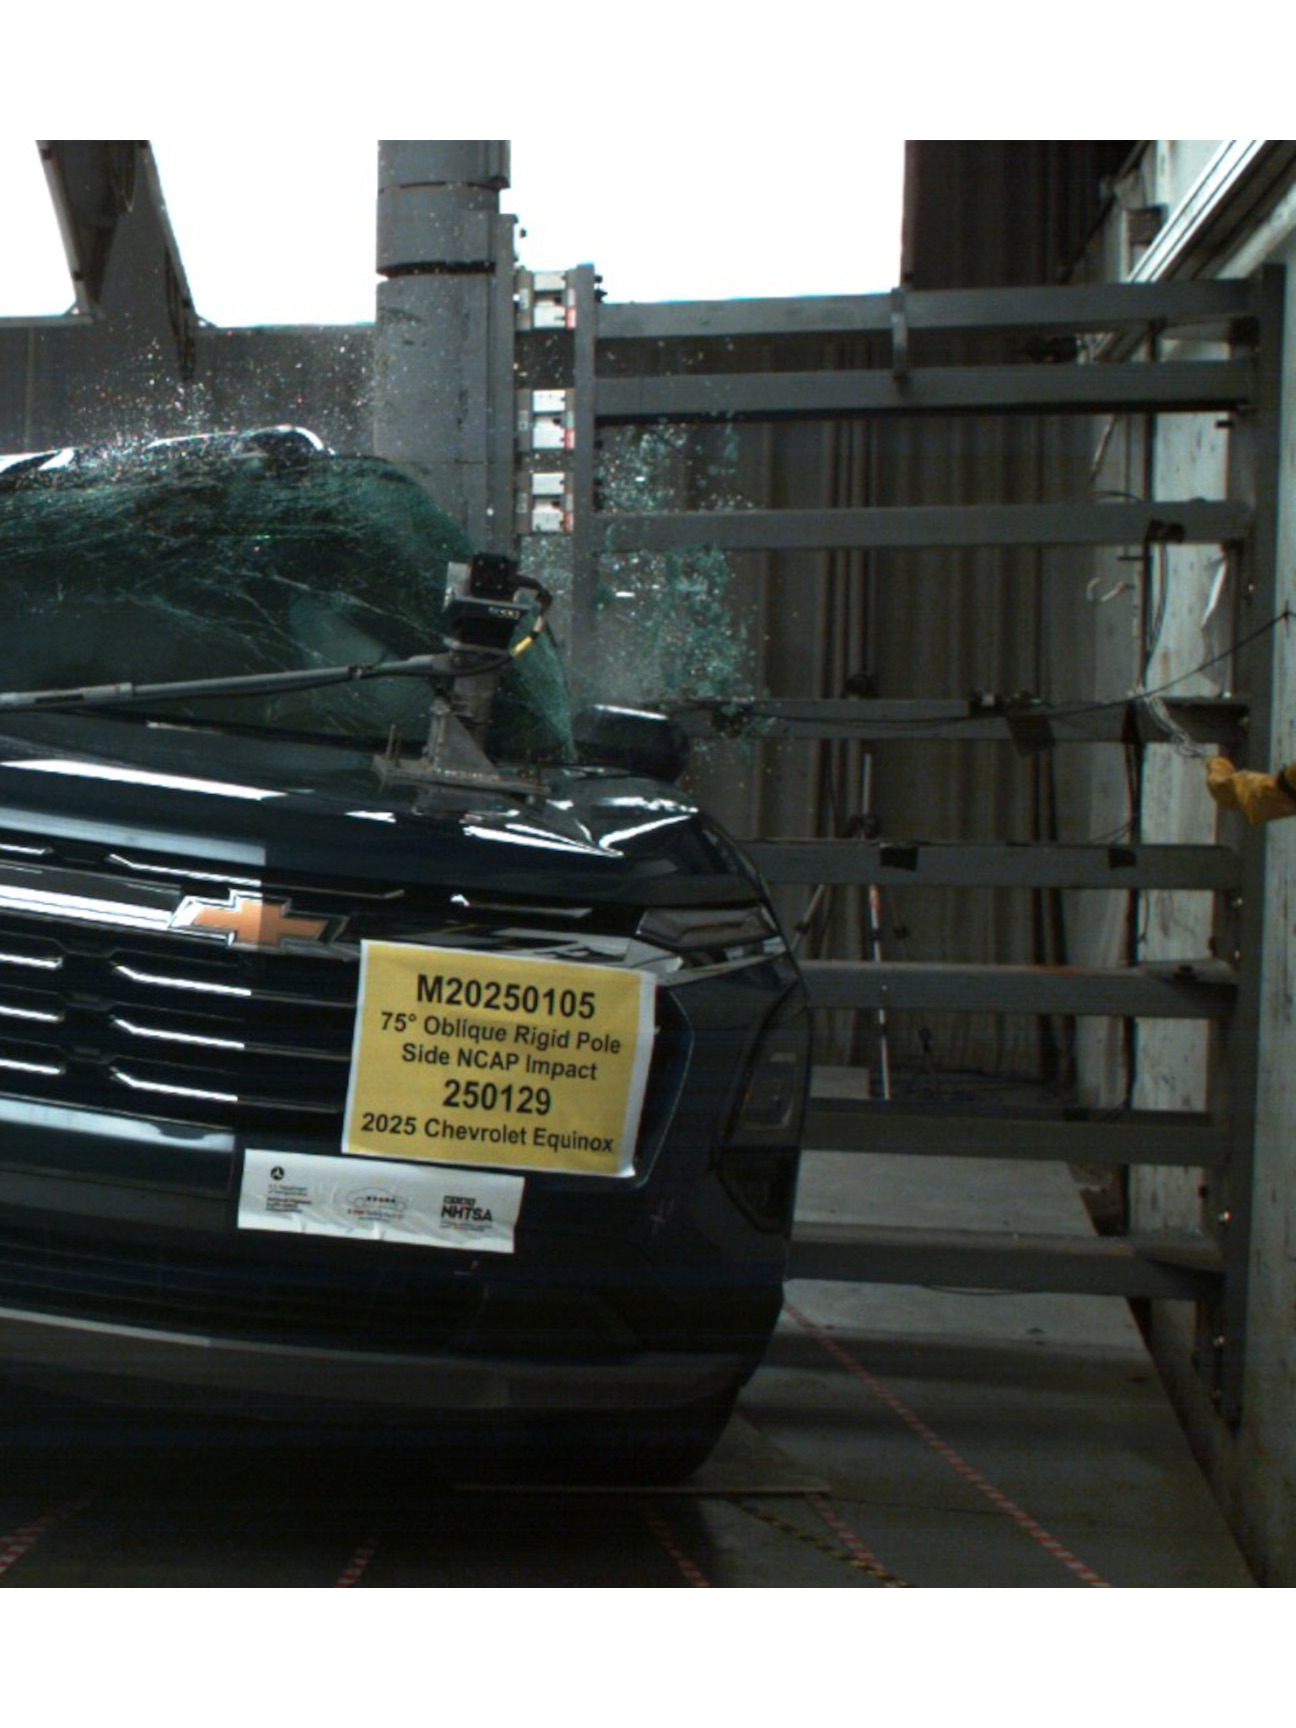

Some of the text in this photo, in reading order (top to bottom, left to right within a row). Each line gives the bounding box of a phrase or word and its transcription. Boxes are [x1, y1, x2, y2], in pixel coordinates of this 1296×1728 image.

[417, 973, 596, 1019] M20250105
[380, 1011, 621, 1054] 75° Oblique Rigid Pole
[401, 1043, 597, 1081] Side NCAP Impact
[442, 1079, 552, 1115] 250129
[360, 1112, 614, 1153] 2025 Chevrolet Equinox
[440, 1205, 493, 1221] NHTSA
